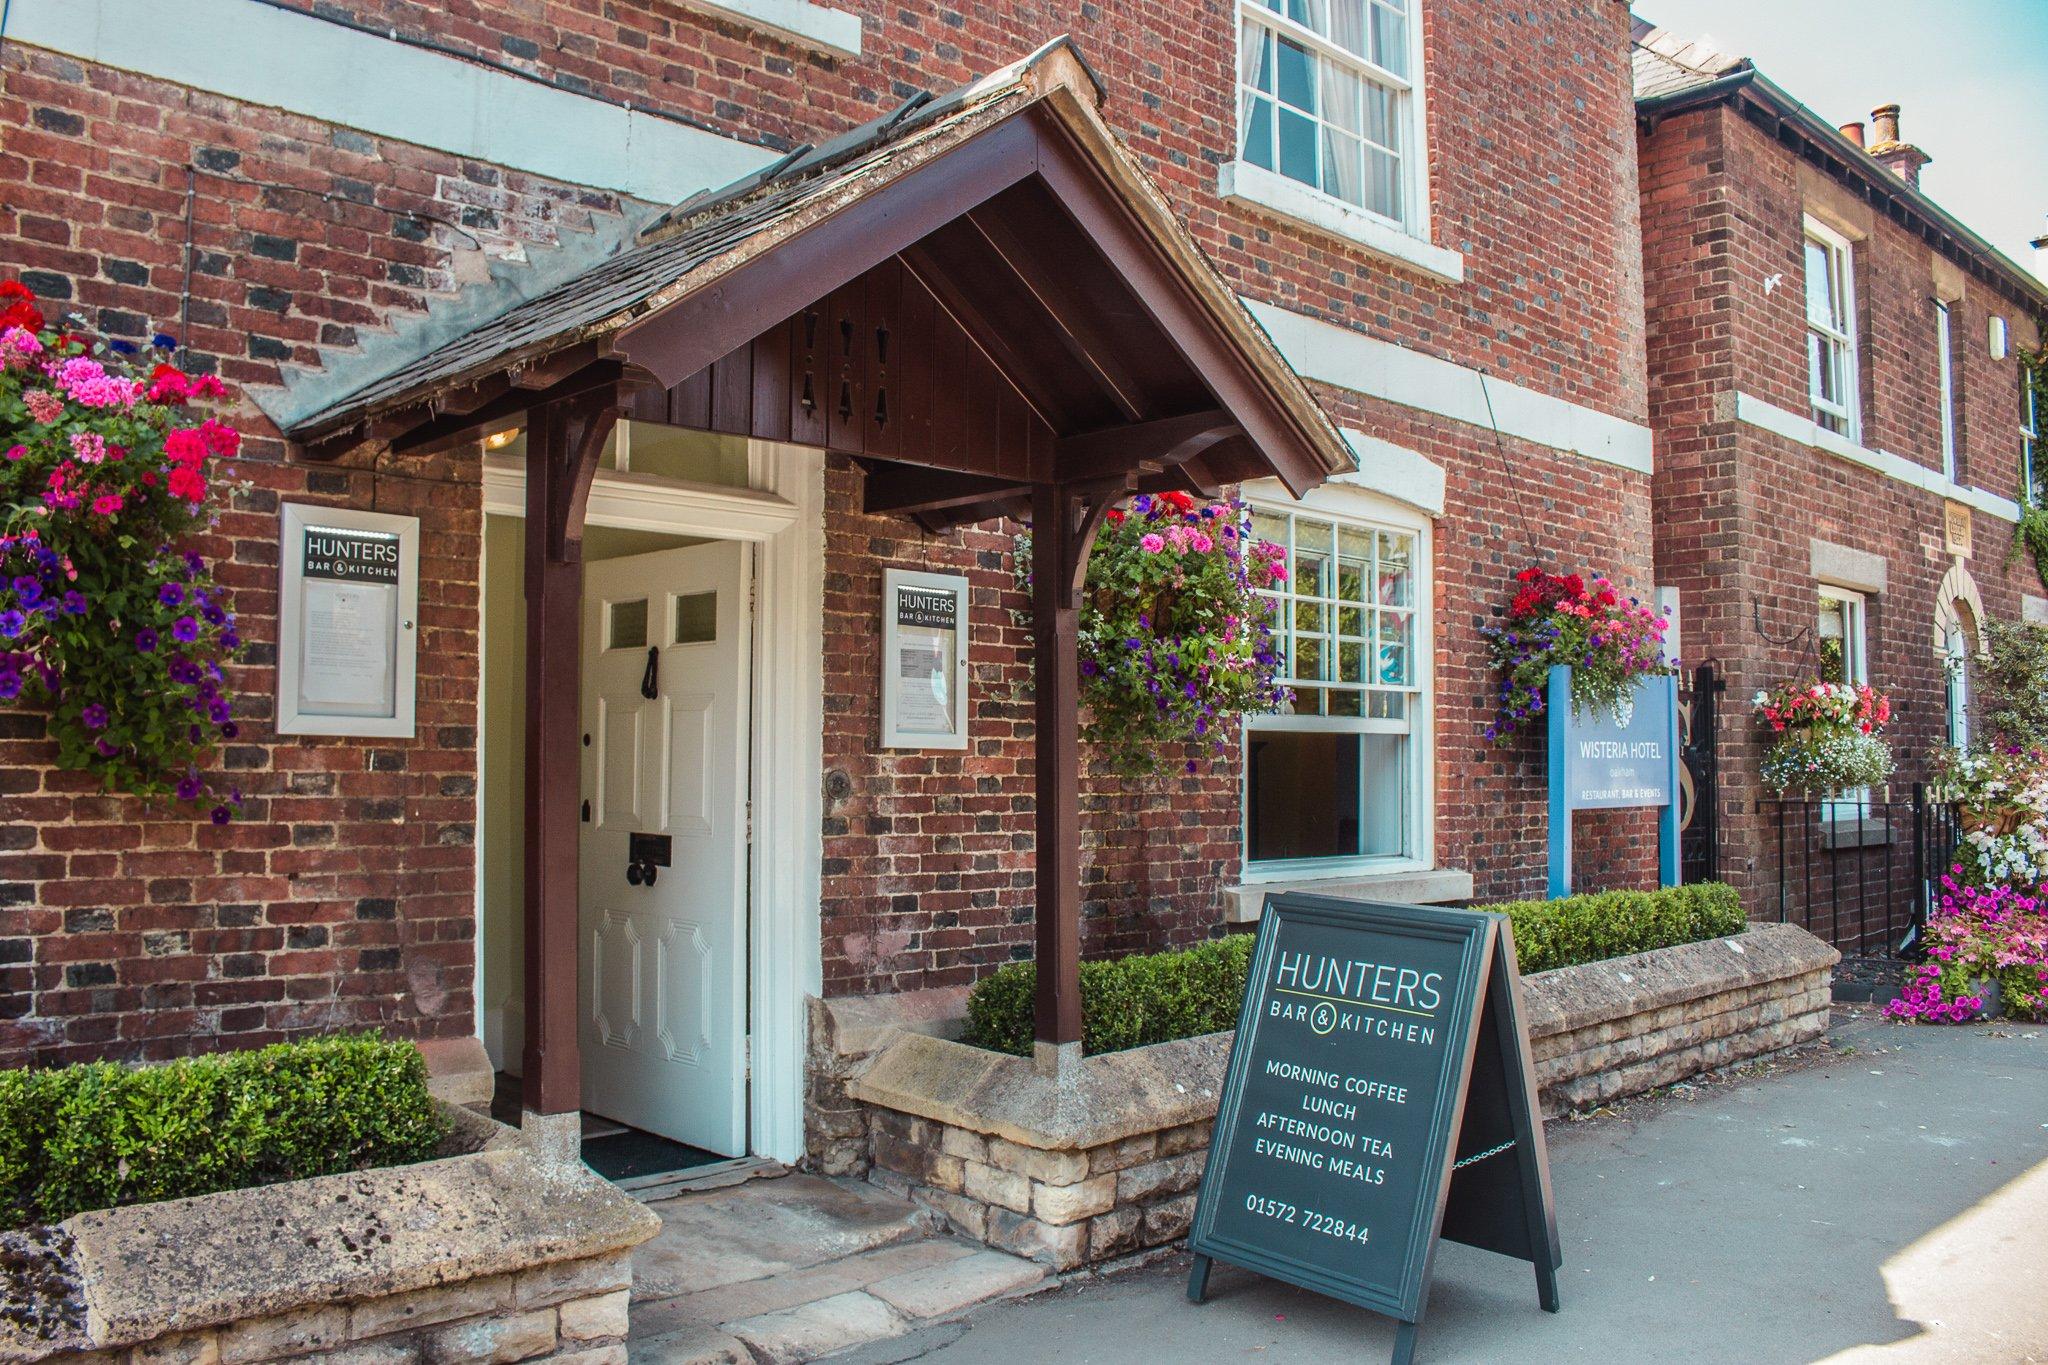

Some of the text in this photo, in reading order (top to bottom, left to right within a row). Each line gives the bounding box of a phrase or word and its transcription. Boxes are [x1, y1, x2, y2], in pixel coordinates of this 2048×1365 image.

[308, 538, 397, 562] HUNTERS
[307, 560, 330, 571] BAR
[348, 565, 397, 577] KITCHEN
[900, 594, 954, 612] HUNTERS
[899, 612, 914, 620] BAR
[924, 615, 955, 624] KITCHEN
[1580, 741, 1662, 759] WISTERIA HOTEL
[1621, 788, 1633, 799] BAR
[1640, 787, 1661, 798] EVENTS
[1277, 951, 1443, 1010] HUNTERS
[1270, 1000, 1307, 1021] BAR
[1340, 1013, 1435, 1045] KITCHEN
[1266, 1060, 1408, 1104] MORNING COFFEE
[1302, 1095, 1357, 1121] LUNCH
[1256, 1112, 1394, 1159] AFTERNOON TEA
[1255, 1138, 1385, 1186] EVENING MEALS
[1246, 1194, 1370, 1246] 01572 722844
